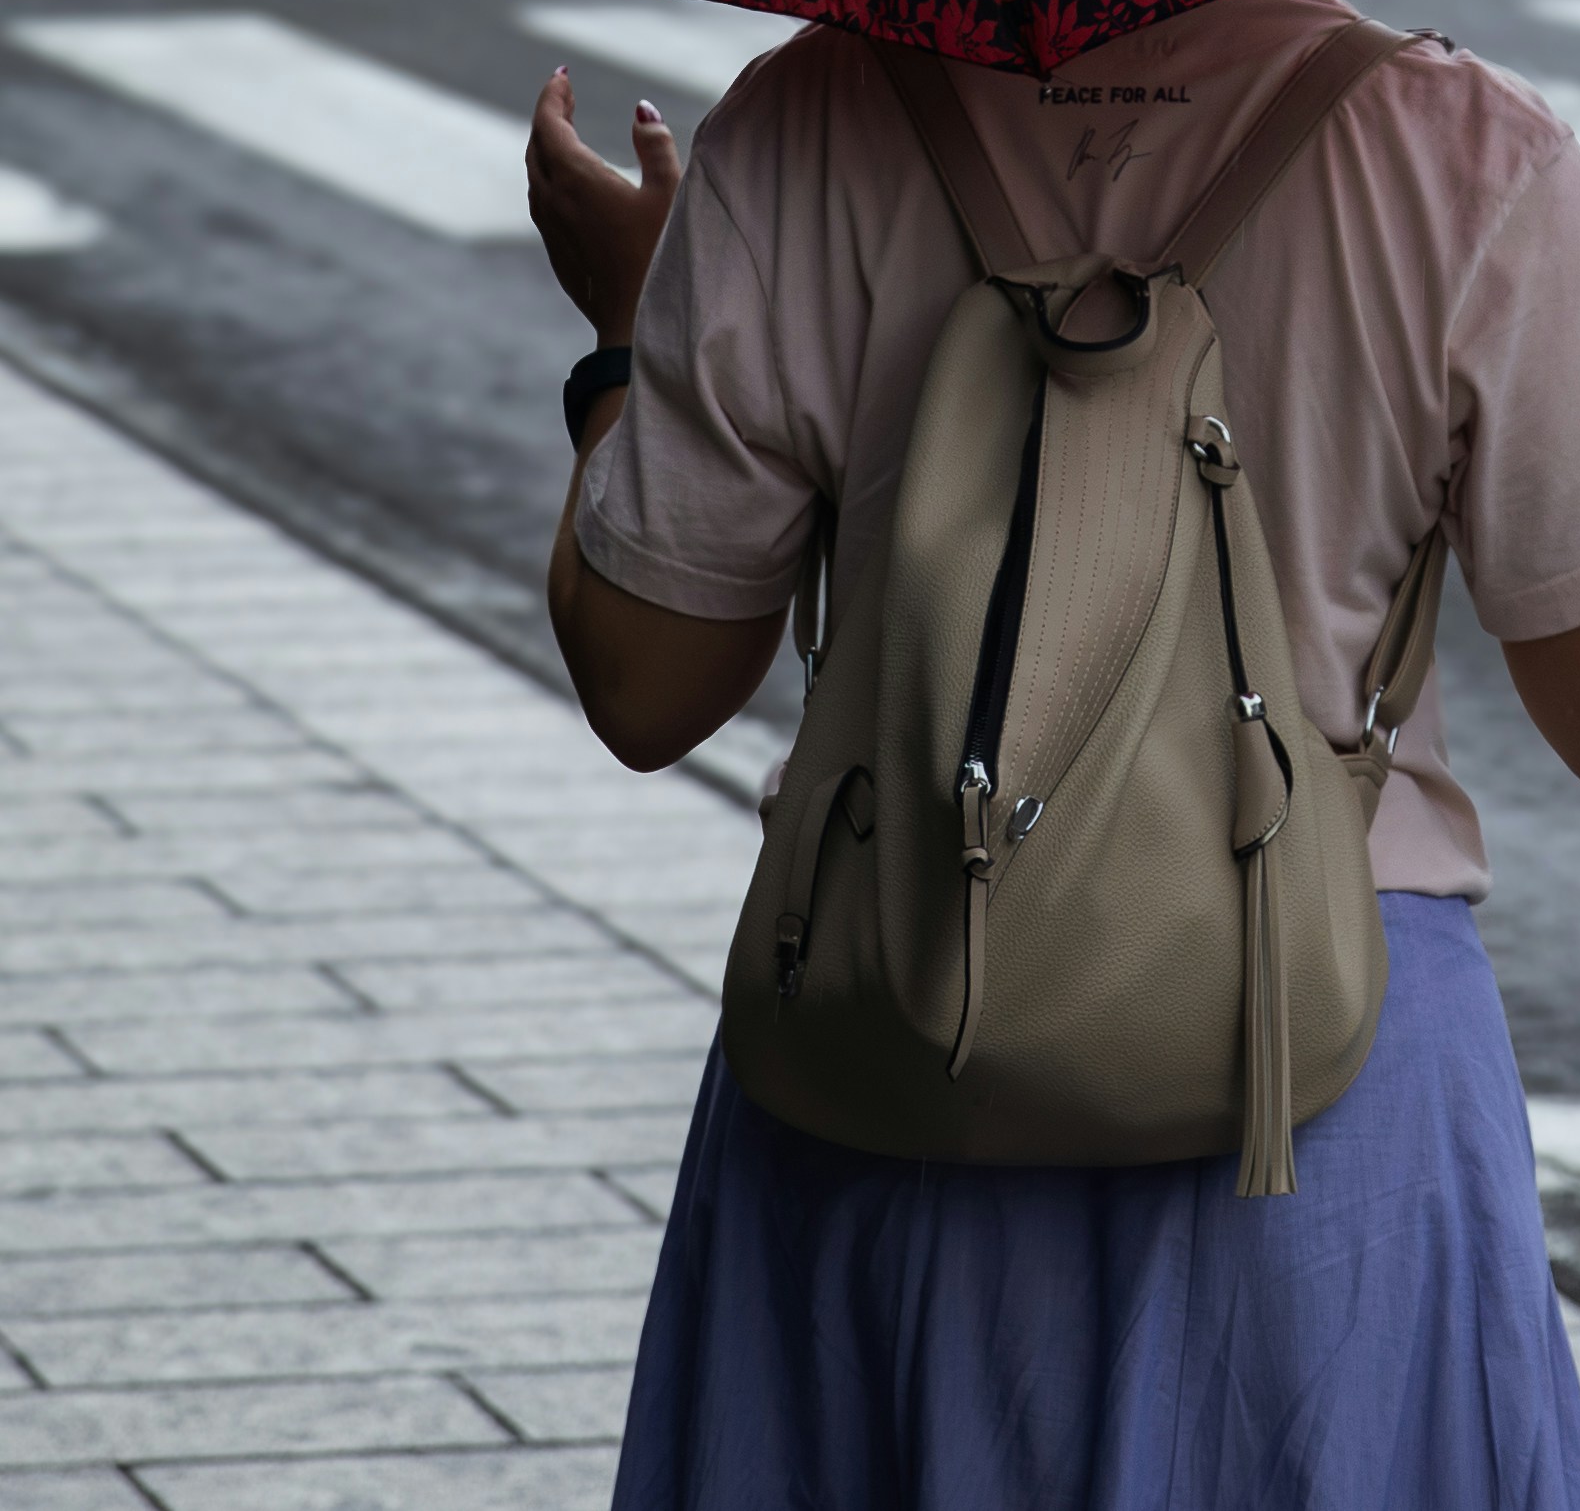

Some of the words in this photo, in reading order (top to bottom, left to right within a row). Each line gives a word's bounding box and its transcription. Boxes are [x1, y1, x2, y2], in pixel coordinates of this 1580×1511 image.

[1039, 86, 1103, 104] PEACE
[1110, 86, 1146, 103] FOR
[1153, 84, 1191, 103] ALL
